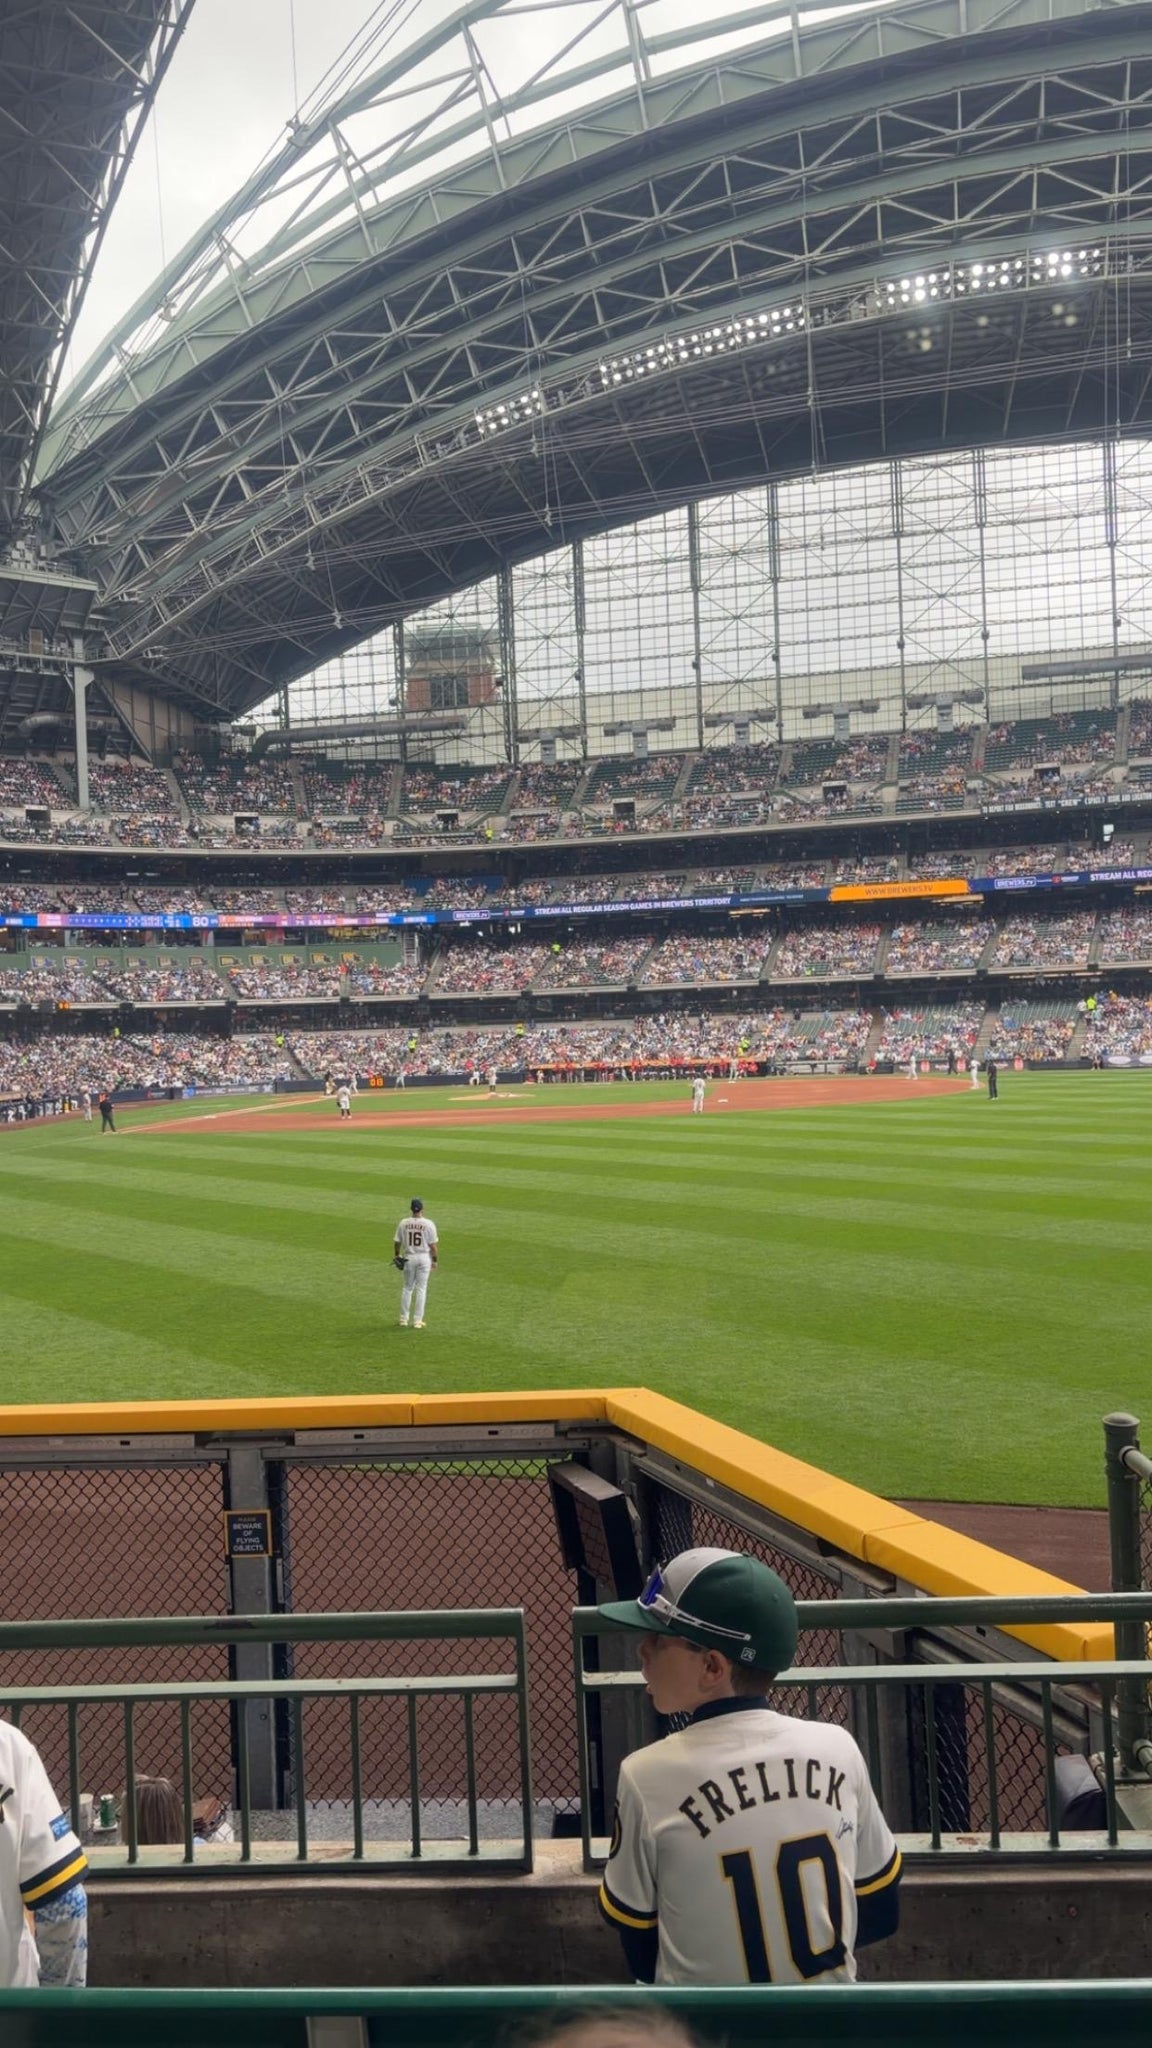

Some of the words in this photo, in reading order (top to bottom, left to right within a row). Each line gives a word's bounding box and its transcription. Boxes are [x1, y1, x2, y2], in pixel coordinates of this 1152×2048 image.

[1090, 872, 1121, 881] STREAM
[1122, 871, 1136, 879] ALL
[535, 908, 557, 916] STREAM
[574, 905, 602, 914] REGULAR
[603, 903, 629, 912] SEASON
[630, 902, 652, 910] GAMES
[653, 901, 661, 909] IN
[662, 899, 694, 908] BREWERS
[695, 897, 731, 906] TERRITORY
[192, 916, 209, 927] 80
[408, 1231, 422, 1246] 16
[232, 1522, 263, 1530] BEWARE
[236, 1537, 260, 1545] FLYING
[232, 1544, 264, 1552] OBJECTS
[679, 1758, 846, 1839] FRELICK
[718, 1830, 848, 1983] 10
